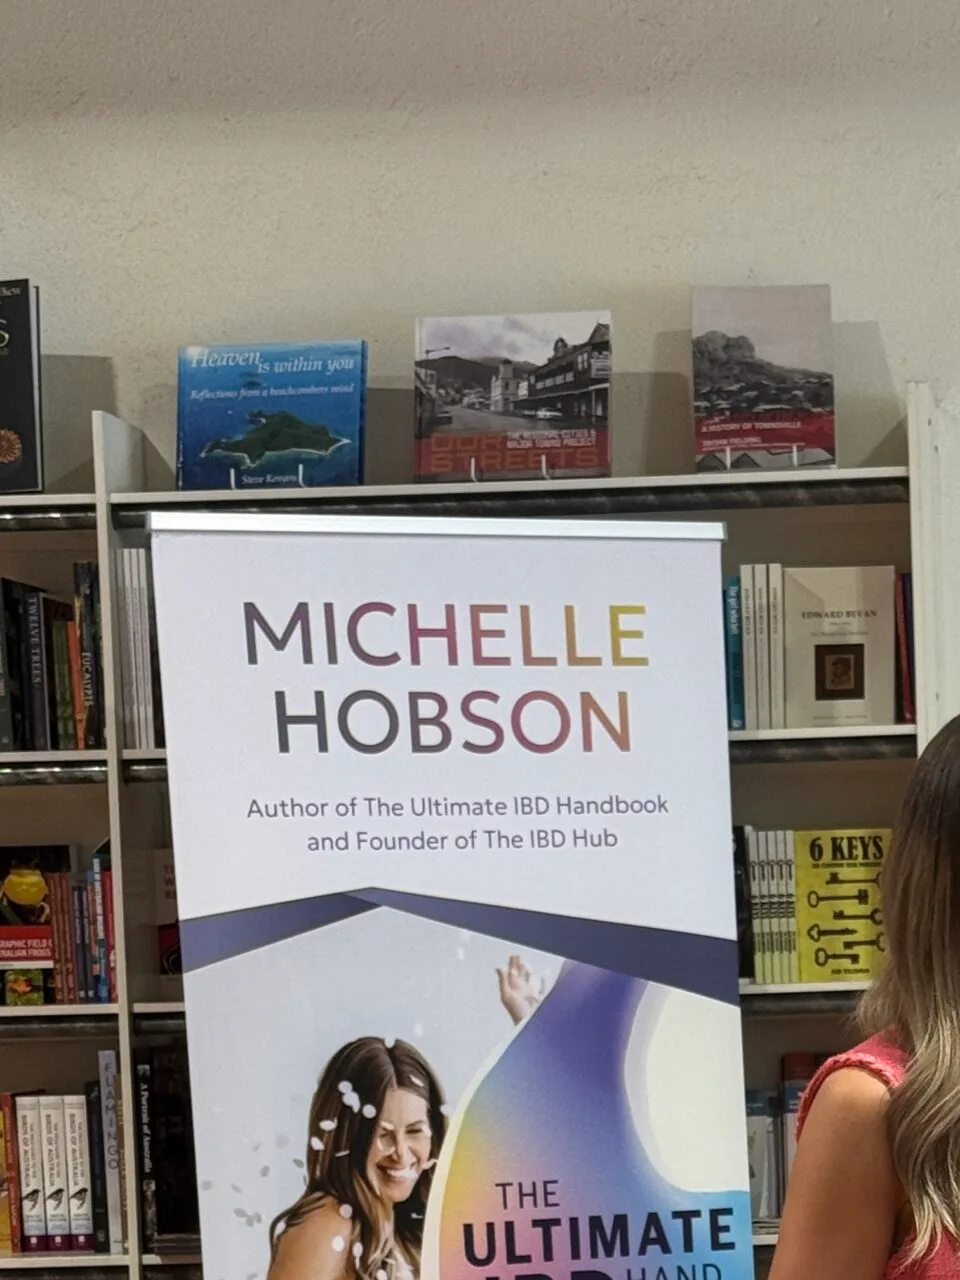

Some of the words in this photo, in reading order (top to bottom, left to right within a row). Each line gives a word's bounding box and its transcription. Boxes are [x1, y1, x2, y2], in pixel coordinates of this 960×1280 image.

[191, 348, 260, 369] Heaven
[257, 359, 270, 373] is
[275, 358, 321, 372] within
[325, 358, 354, 375] you
[431, 432, 501, 450] OUR
[431, 447, 600, 472] STREETS
[27, 597, 40, 644] TWELVE
[802, 611, 844, 620] EDWARD
[243, 601, 649, 666] MICHELLE
[31, 645, 41, 684] TREES
[274, 690, 631, 754] HOBSON
[247, 798, 328, 818] Author
[335, 797, 358, 817] of
[363, 797, 403, 817] The
[410, 796, 507, 817] Ultimate
[514, 797, 549, 816] IBD
[556, 795, 669, 815] Handbook
[307, 831, 349, 851] and
[357, 830, 448, 851] Founder
[454, 830, 477, 849] of
[483, 830, 523, 849] The
[530, 829, 565, 848] IBD
[573, 828, 618, 848] Hub
[809, 837, 823, 861] 6
[830, 835, 884, 860] KEYS
[140, 1091, 150, 1124] Portrait
[495, 1180, 560, 1210] THE
[463, 1208, 736, 1267] ULTIMATE
